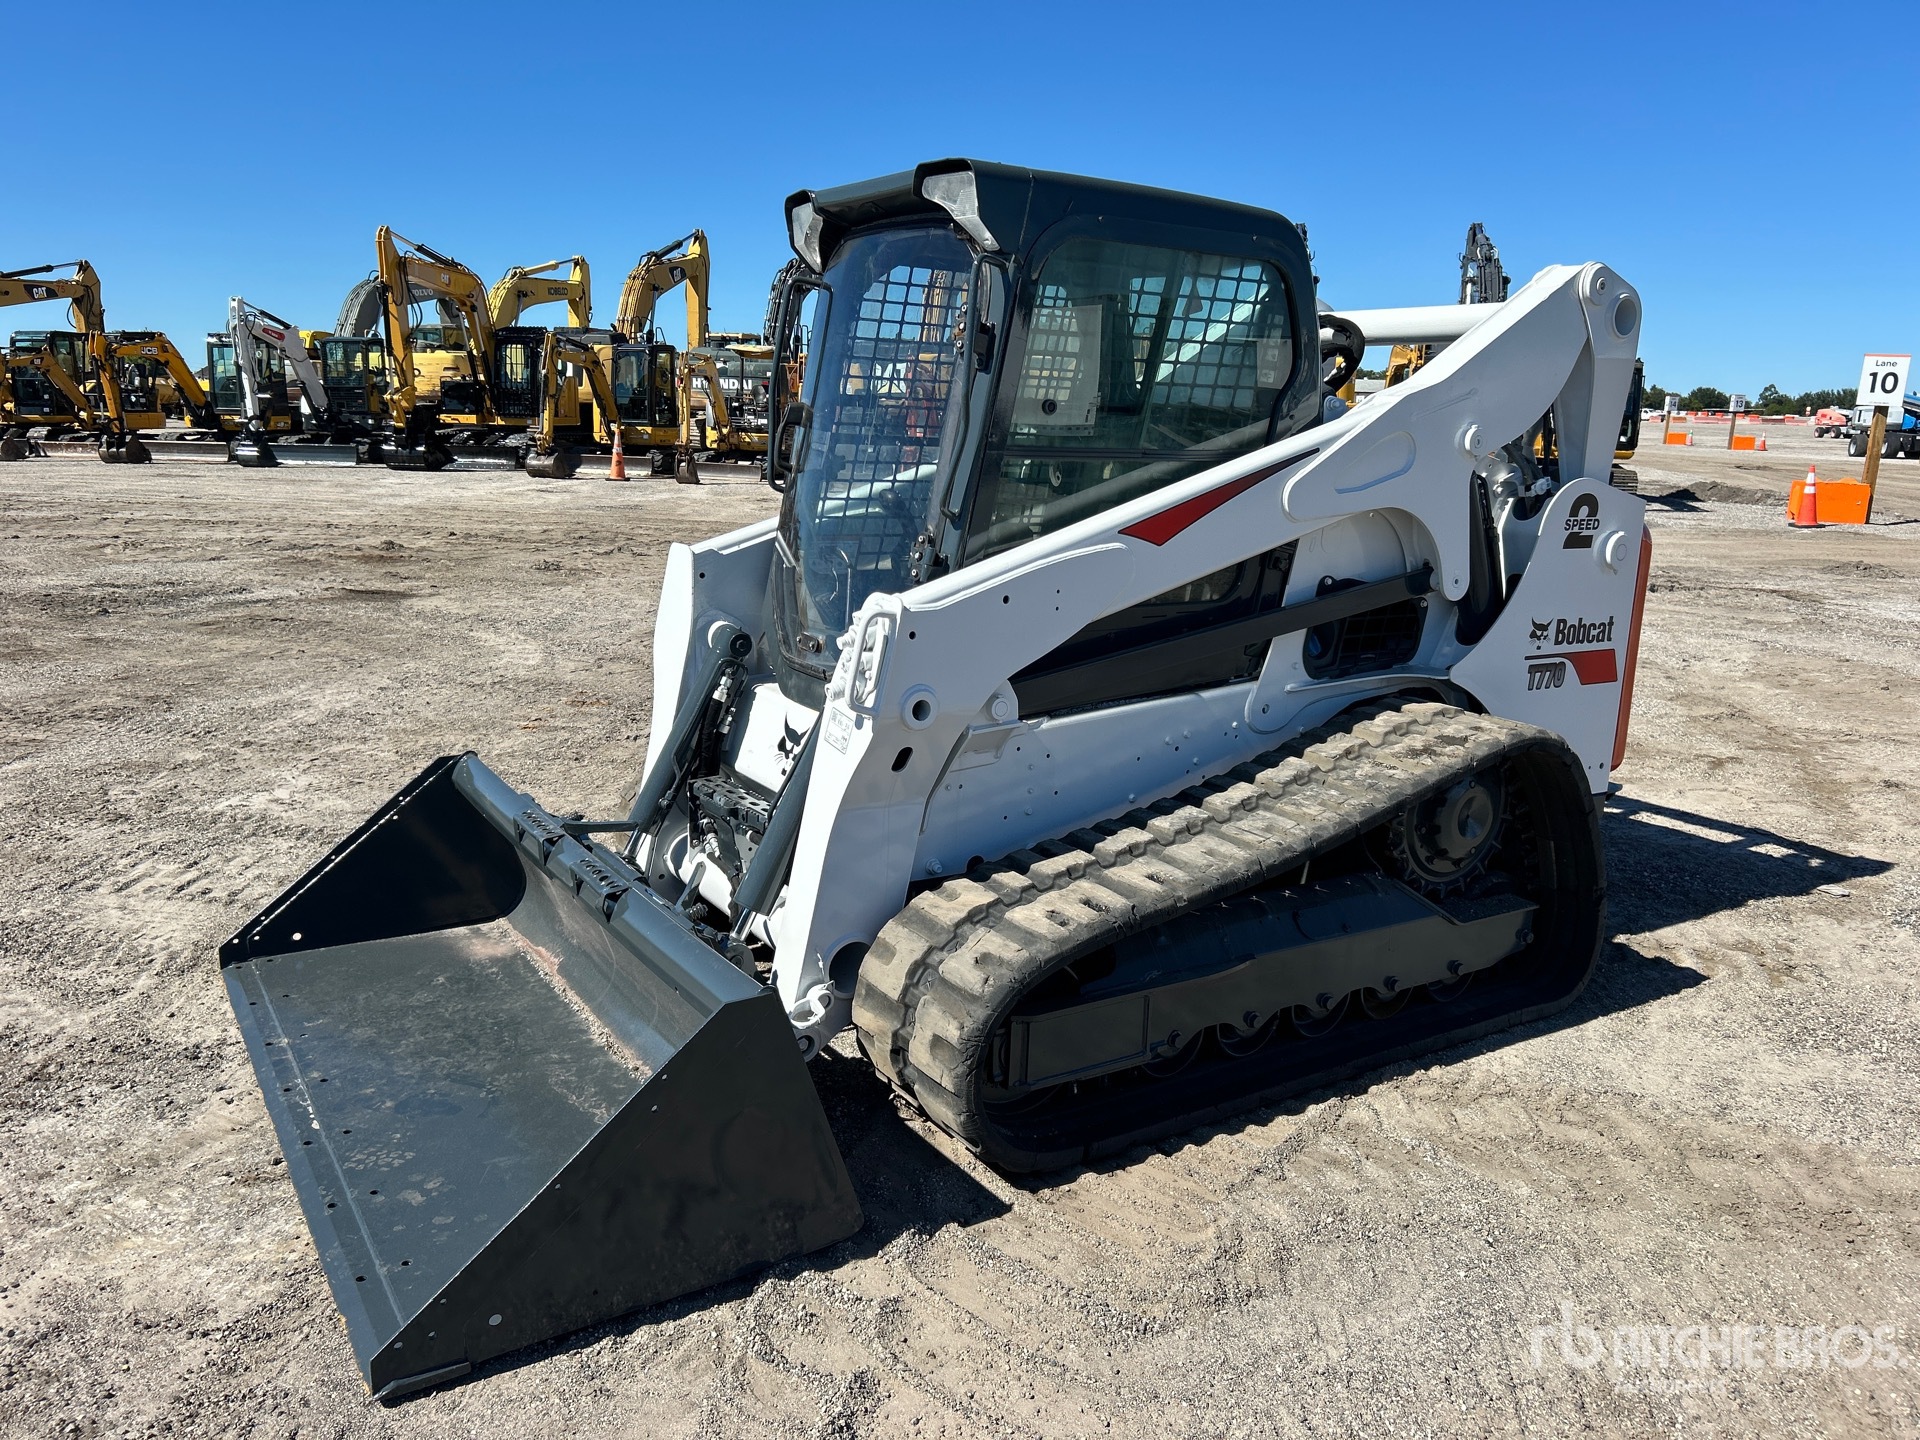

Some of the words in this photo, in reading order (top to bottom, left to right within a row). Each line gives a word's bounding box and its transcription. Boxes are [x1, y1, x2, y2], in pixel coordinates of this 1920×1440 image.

[33, 287, 47, 299] CAT
[55, 284, 66, 293] 75
[692, 377, 752, 390] HYNDAI
[1869, 372, 1899, 394] 10
[1735, 400, 1743, 408] 13
[1563, 493, 1599, 549] 2
[1564, 519, 1600, 531] SPEED
[1554, 616, 1614, 645] Bobcat
[1528, 661, 1566, 691] T770
